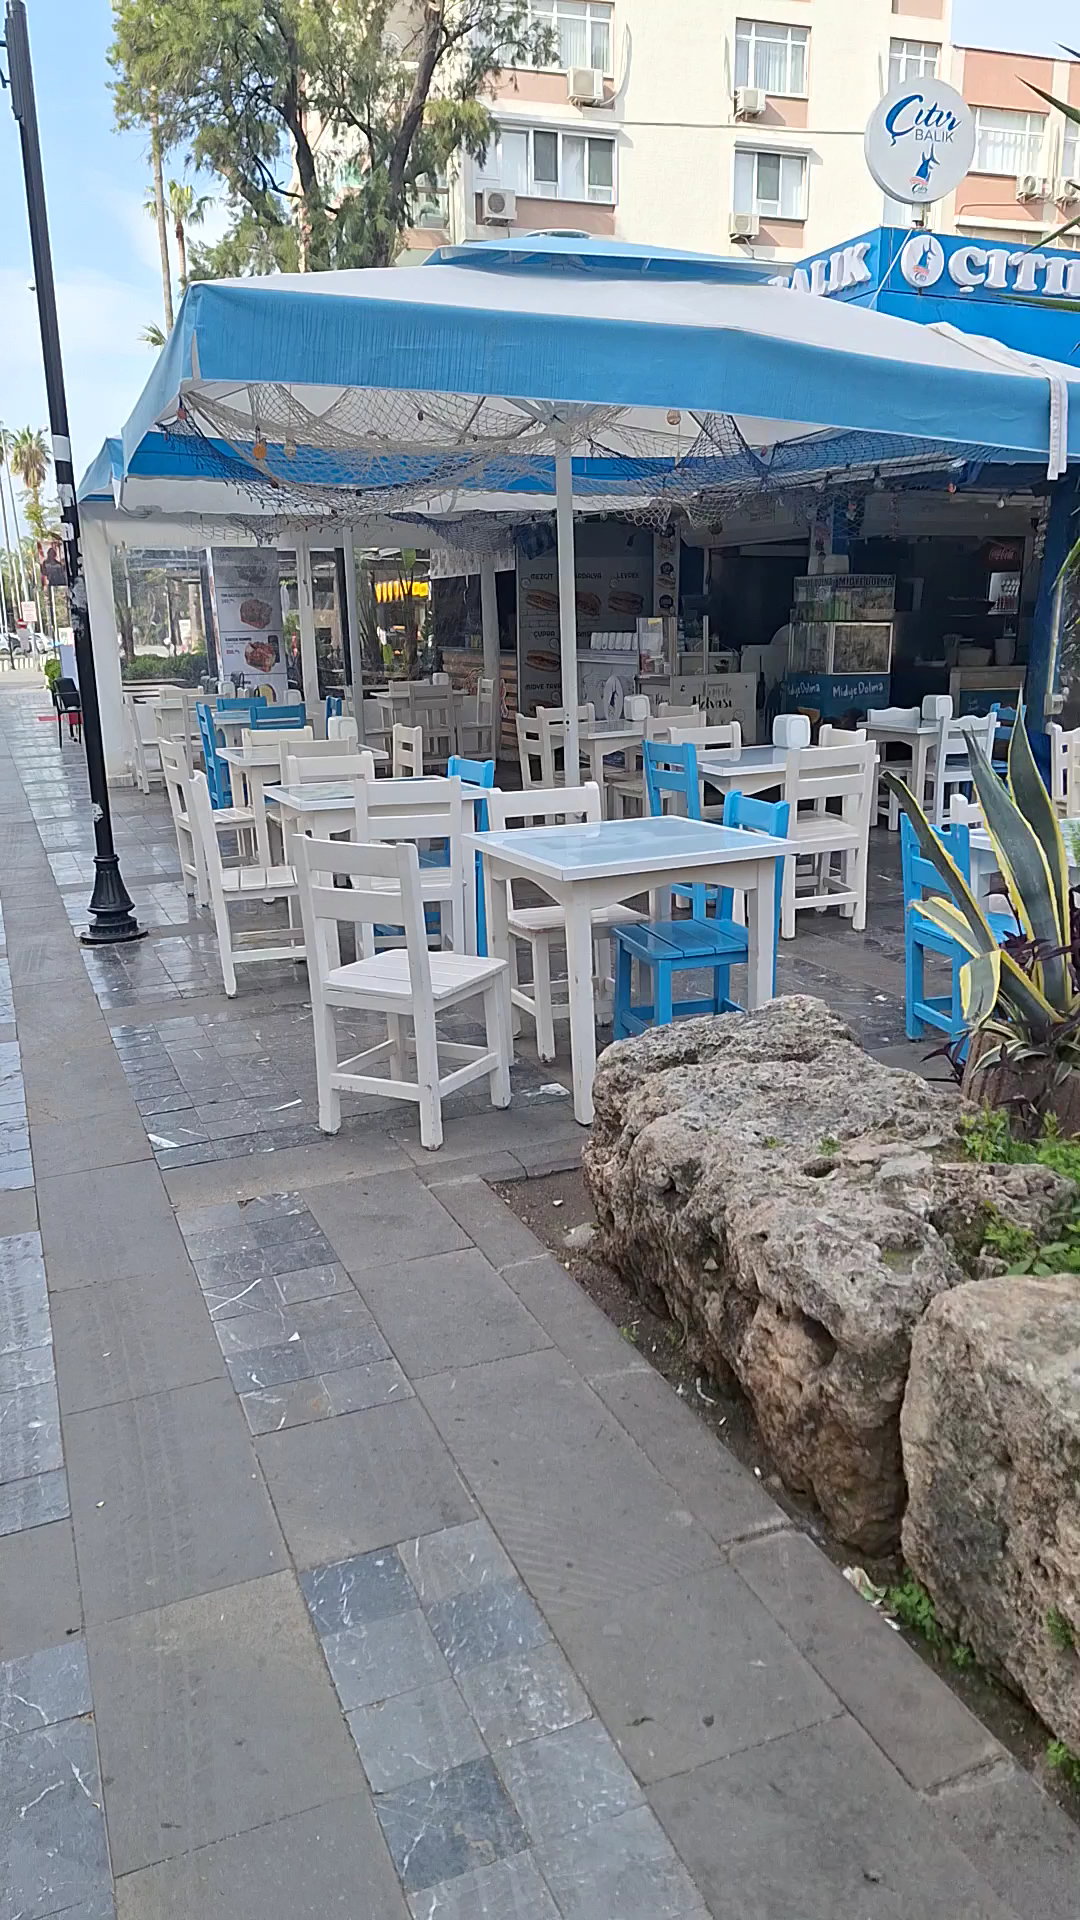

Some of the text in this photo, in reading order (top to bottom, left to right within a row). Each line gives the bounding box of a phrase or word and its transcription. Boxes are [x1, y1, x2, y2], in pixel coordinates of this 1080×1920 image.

[885, 94, 962, 147] Çıtır
[915, 129, 955, 143] BALIK
[858, 681, 884, 694] Dolma
